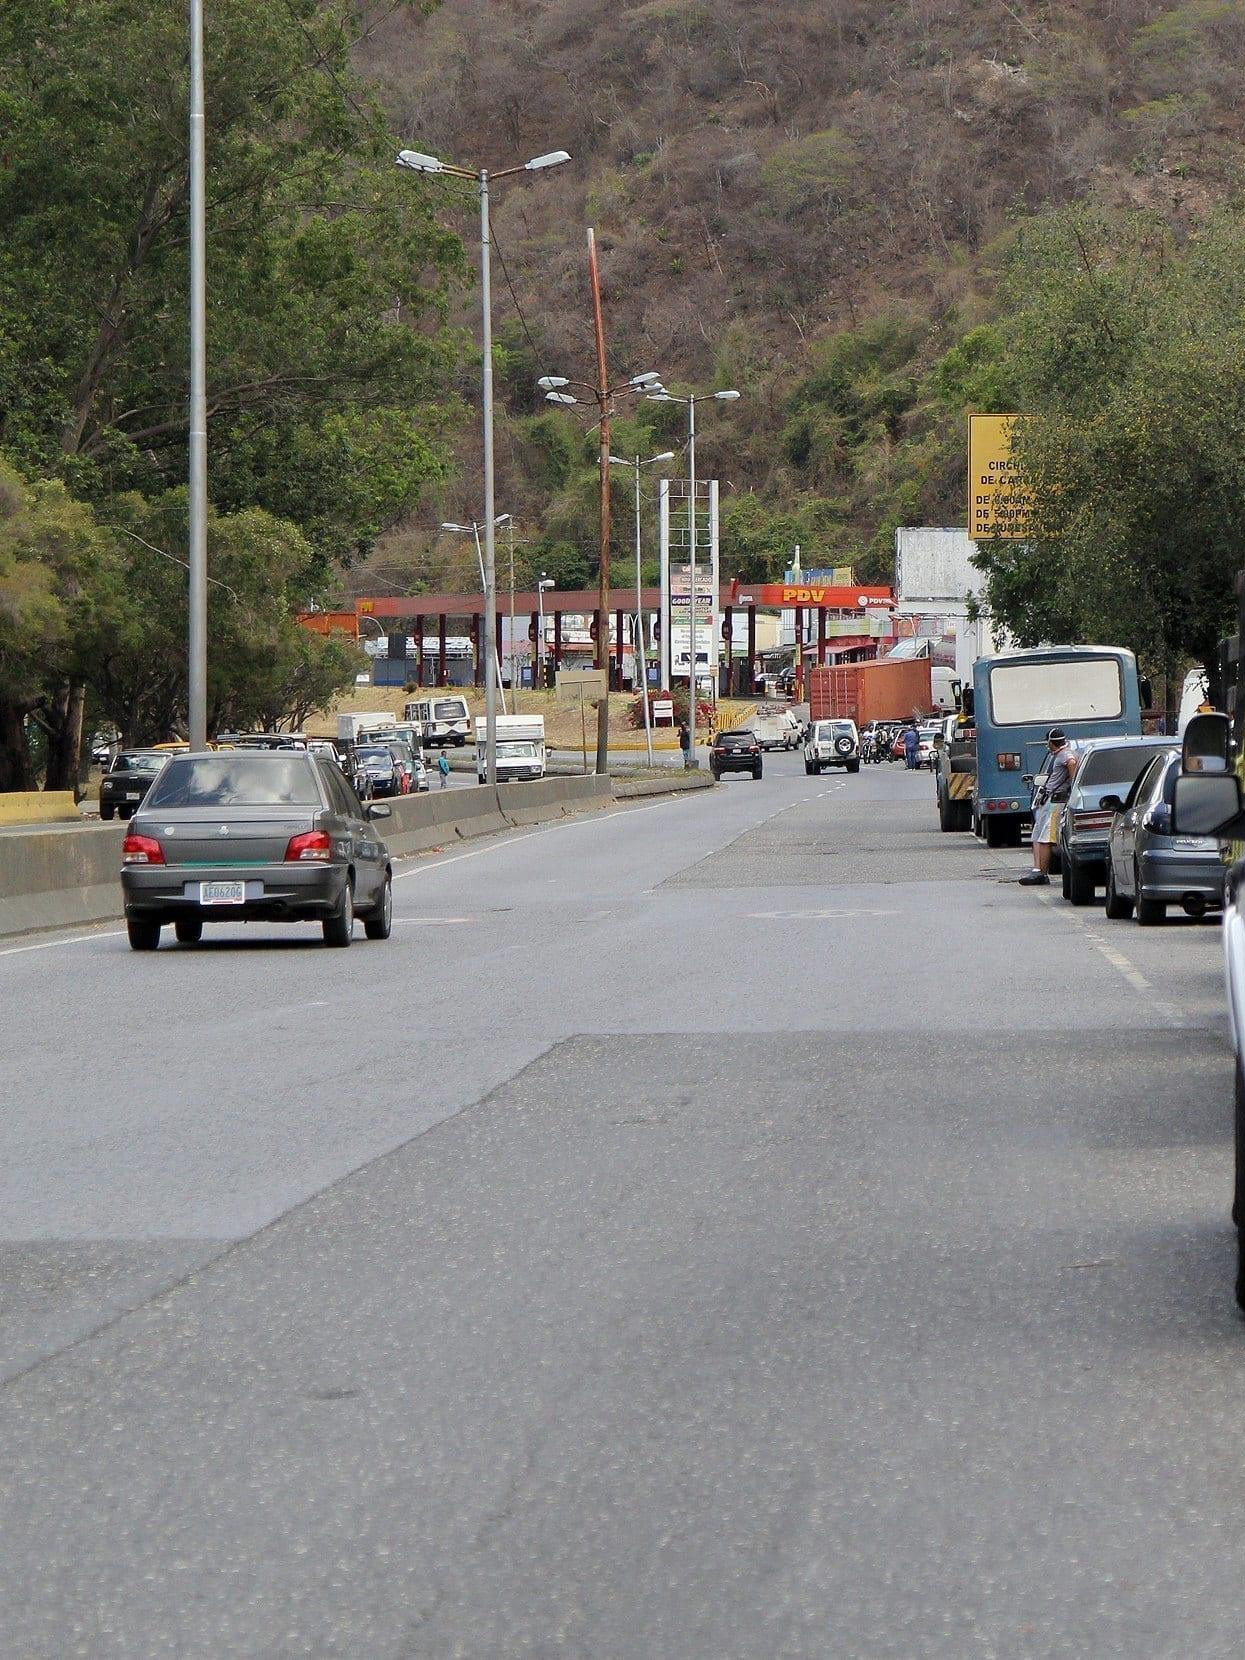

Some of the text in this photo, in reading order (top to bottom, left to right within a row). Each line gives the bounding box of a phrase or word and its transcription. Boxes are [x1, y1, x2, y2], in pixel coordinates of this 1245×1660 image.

[981, 475, 995, 485] DE
[976, 495, 990, 505] DE
[976, 509, 990, 519] DE
[976, 523, 990, 533] DE
[783, 589, 825, 603] PDV
